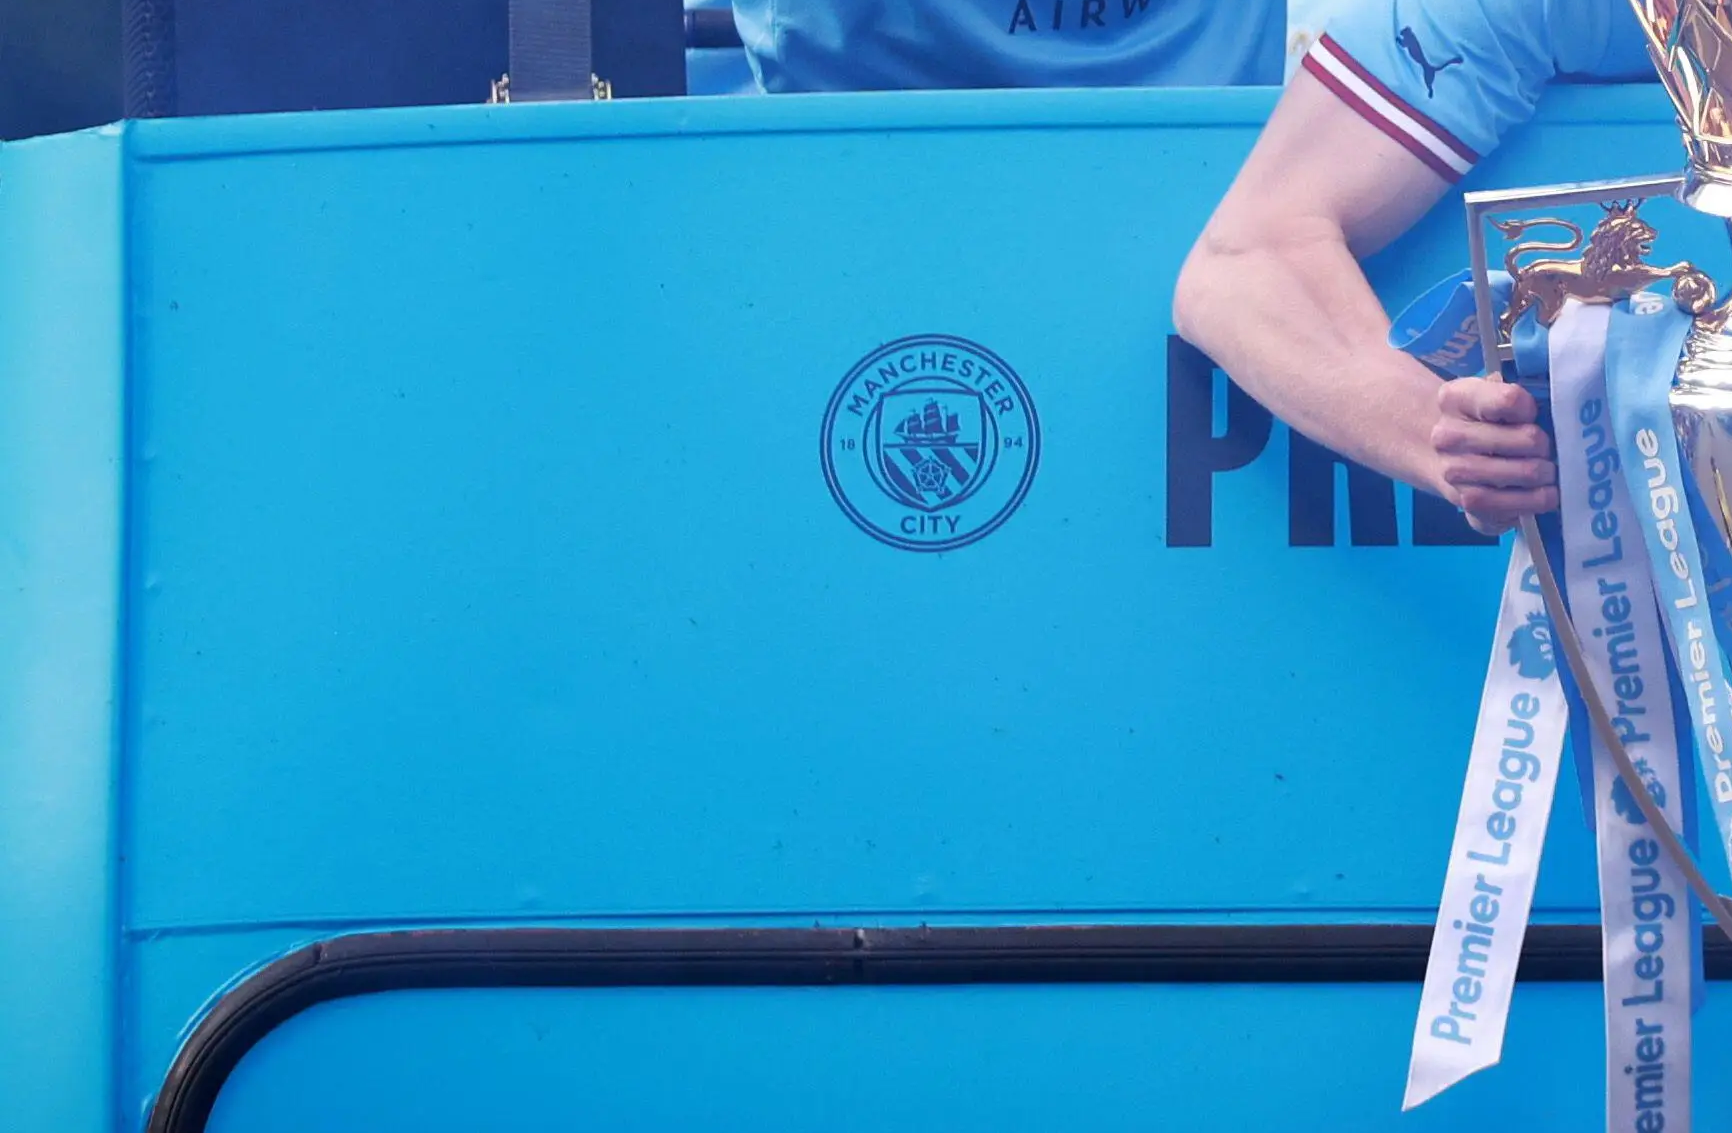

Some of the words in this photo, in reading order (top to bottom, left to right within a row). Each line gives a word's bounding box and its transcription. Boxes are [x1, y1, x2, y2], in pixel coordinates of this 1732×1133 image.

[840, 438, 856, 451] 18
[847, 351, 1014, 417] MANCHESTER
[1003, 436, 1024, 449] 94
[900, 515, 961, 535] CITY
[1580, 397, 1624, 569] League
[1636, 428, 1698, 610] League
[1593, 578, 1650, 746] Premier
[1430, 875, 1504, 1045] Premier
[1467, 692, 1541, 866] League
[1622, 836, 1673, 1007] League
[1624, 1018, 1665, 1133] emier
